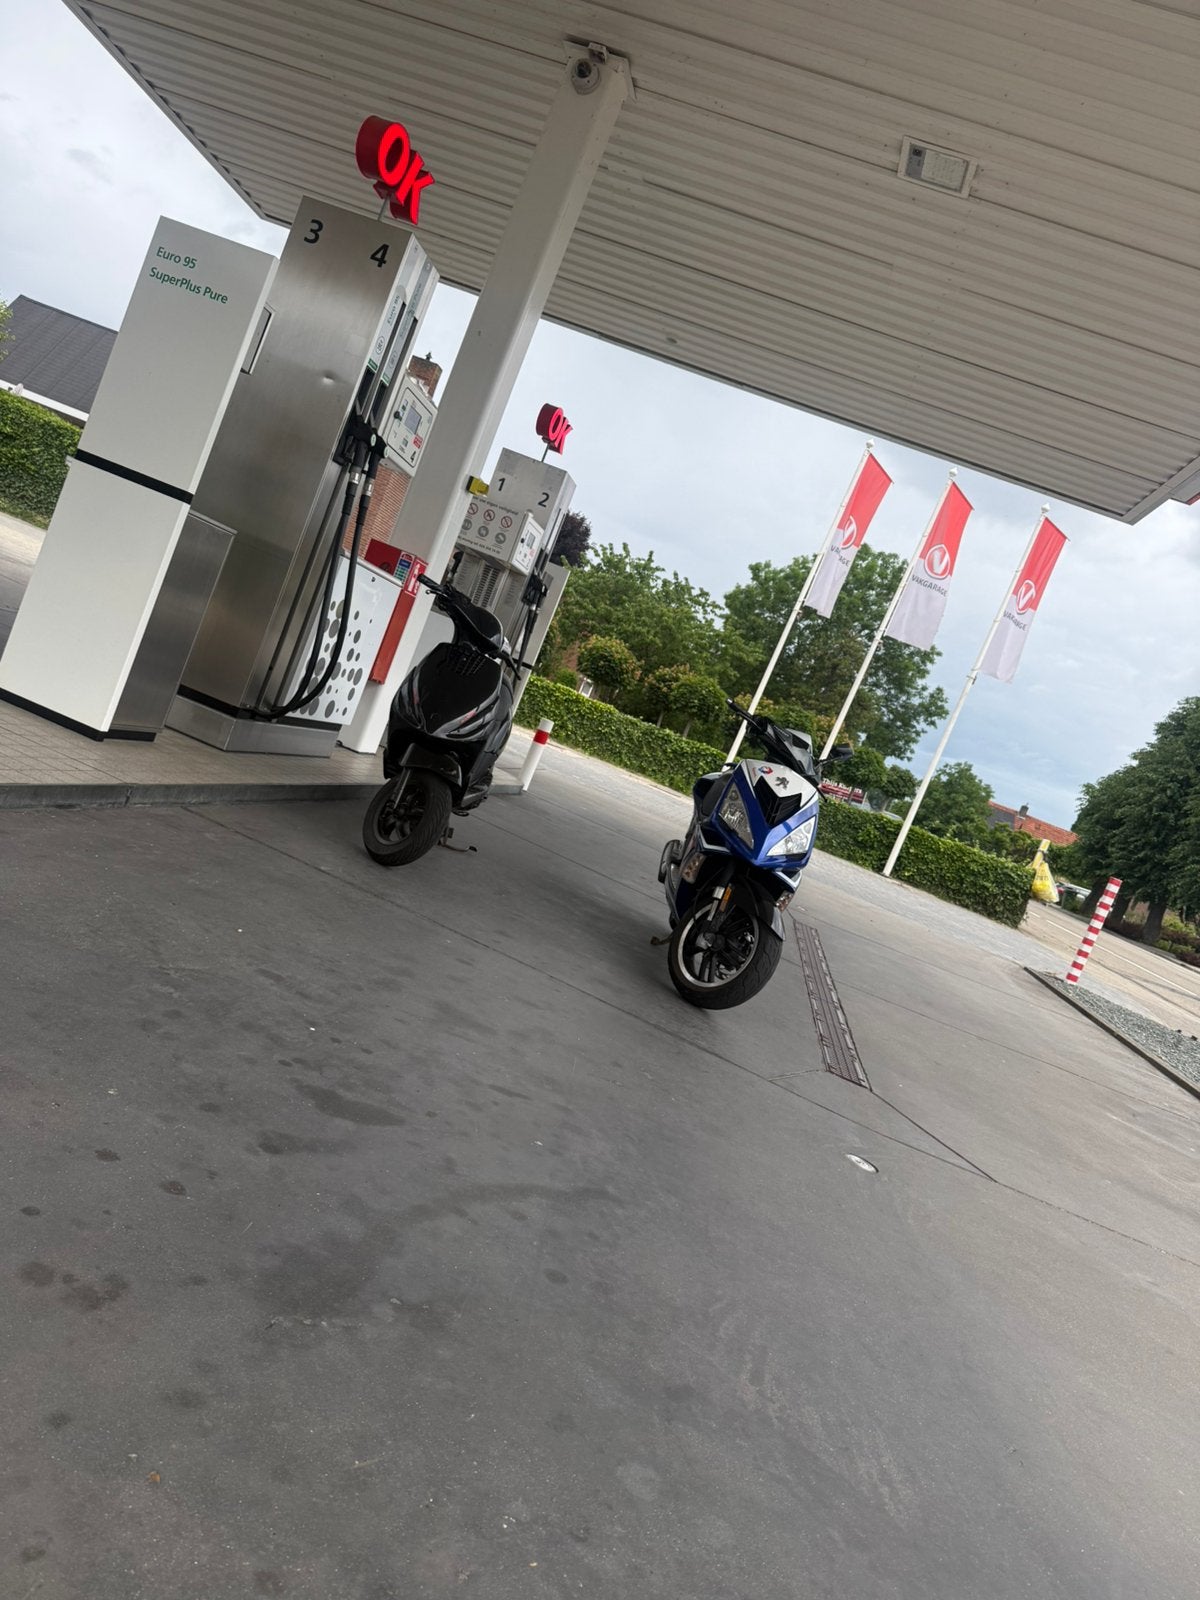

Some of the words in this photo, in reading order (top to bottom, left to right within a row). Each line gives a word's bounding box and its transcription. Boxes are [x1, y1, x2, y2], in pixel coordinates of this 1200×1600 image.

[376, 121, 436, 226] OK
[304, 218, 324, 244] 3
[156, 246, 181, 263] Euro
[183, 256, 197, 269] 95
[370, 243, 389, 268] 4
[149, 267, 202, 294] SuperPlus
[203, 286, 228, 304] Pure
[547, 406, 573, 456] OK
[410, 450, 417, 463] 4
[498, 477, 506, 491] 1
[538, 492, 550, 508] 2
[911, 575, 948, 598] VAKGARAGE
